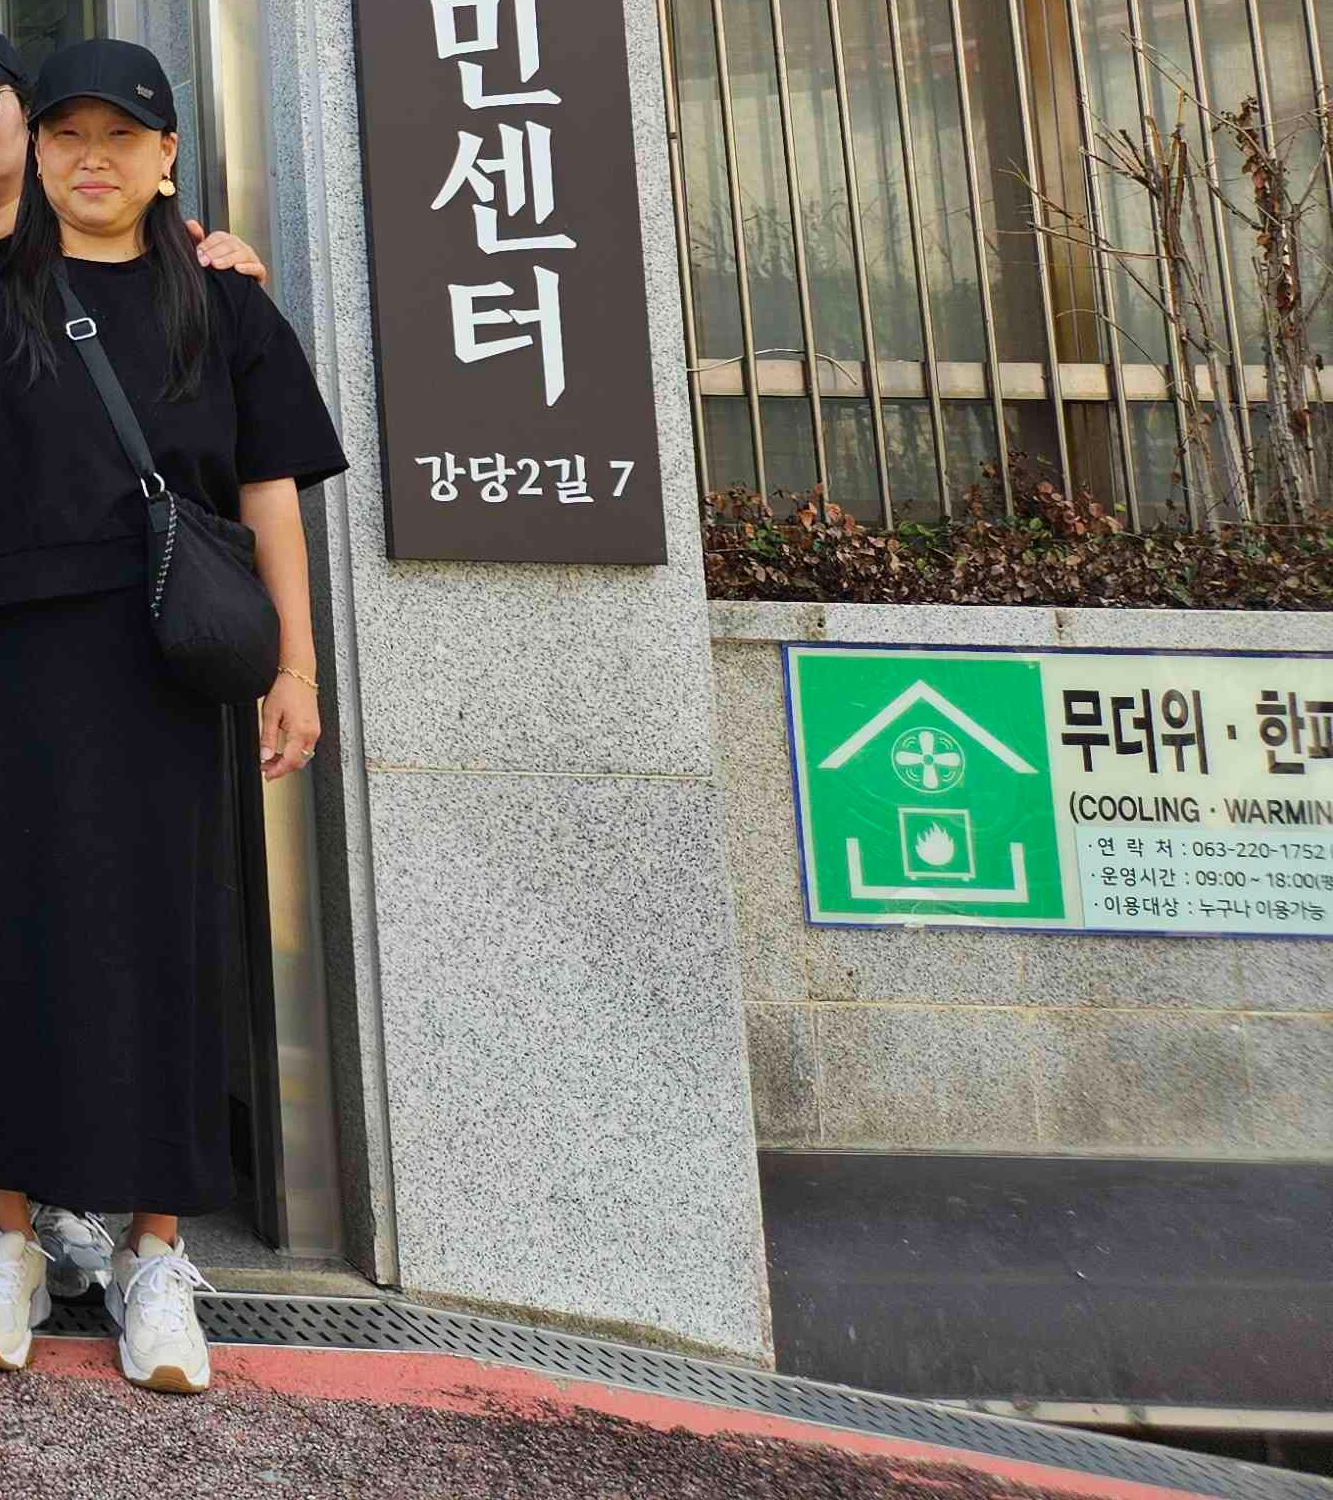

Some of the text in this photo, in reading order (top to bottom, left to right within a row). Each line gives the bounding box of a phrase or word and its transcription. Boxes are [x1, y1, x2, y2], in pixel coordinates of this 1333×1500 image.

[414, 452, 635, 503] 강당2길 7
[1061, 689, 1209, 775] 무더위
[1070, 791, 1201, 824] (COOLING
[1192, 841, 1327, 860] 063-220-1752
[1101, 866, 1176, 888] 운영시간
[1104, 896, 1180, 918] 이용대상
[1199, 899, 1251, 919] 누구나
[1256, 900, 1326, 921] 이용가능
